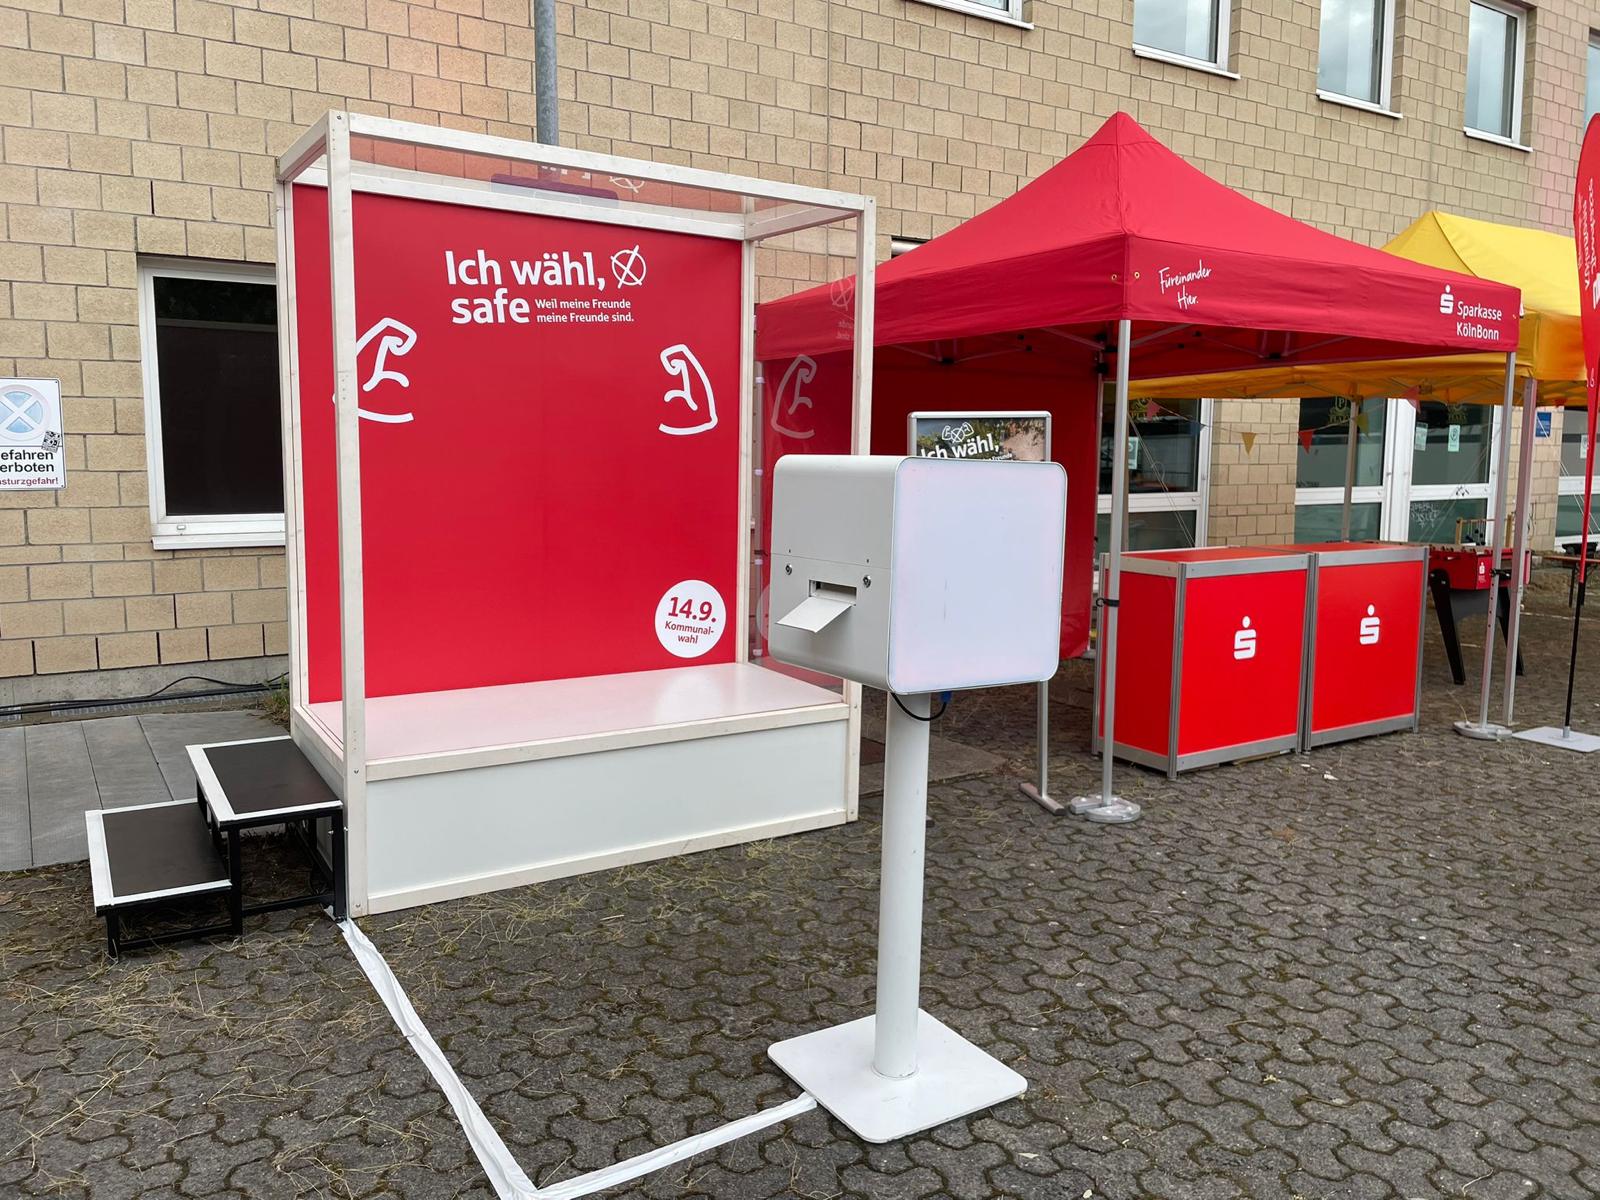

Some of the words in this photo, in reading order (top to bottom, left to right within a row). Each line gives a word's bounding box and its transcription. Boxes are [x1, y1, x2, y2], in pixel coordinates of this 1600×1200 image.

[445, 249, 502, 286] Ich
[510, 251, 606, 292] wähl,
[1158, 258, 1212, 294] Füreinander
[451, 287, 531, 325] safe
[535, 298, 558, 309] Weil
[560, 299, 590, 309] meine
[592, 298, 631, 310] Freunde
[1177, 285, 1199, 309] Hier.
[537, 312, 568, 323] meine
[570, 312, 610, 323] Freunde
[611, 312, 634, 322] sind.
[1456, 300, 1503, 320] Sparkasse
[1456, 321, 1500, 341] KölnBonn
[1, 449, 53, 460] efahren
[951, 433, 1000, 459] wähl,
[0, 462, 54, 472] erboten
[669, 597, 716, 622] 14.9.
[665, 621, 714, 635] Kommunal-
[678, 635, 698, 644] wahl
